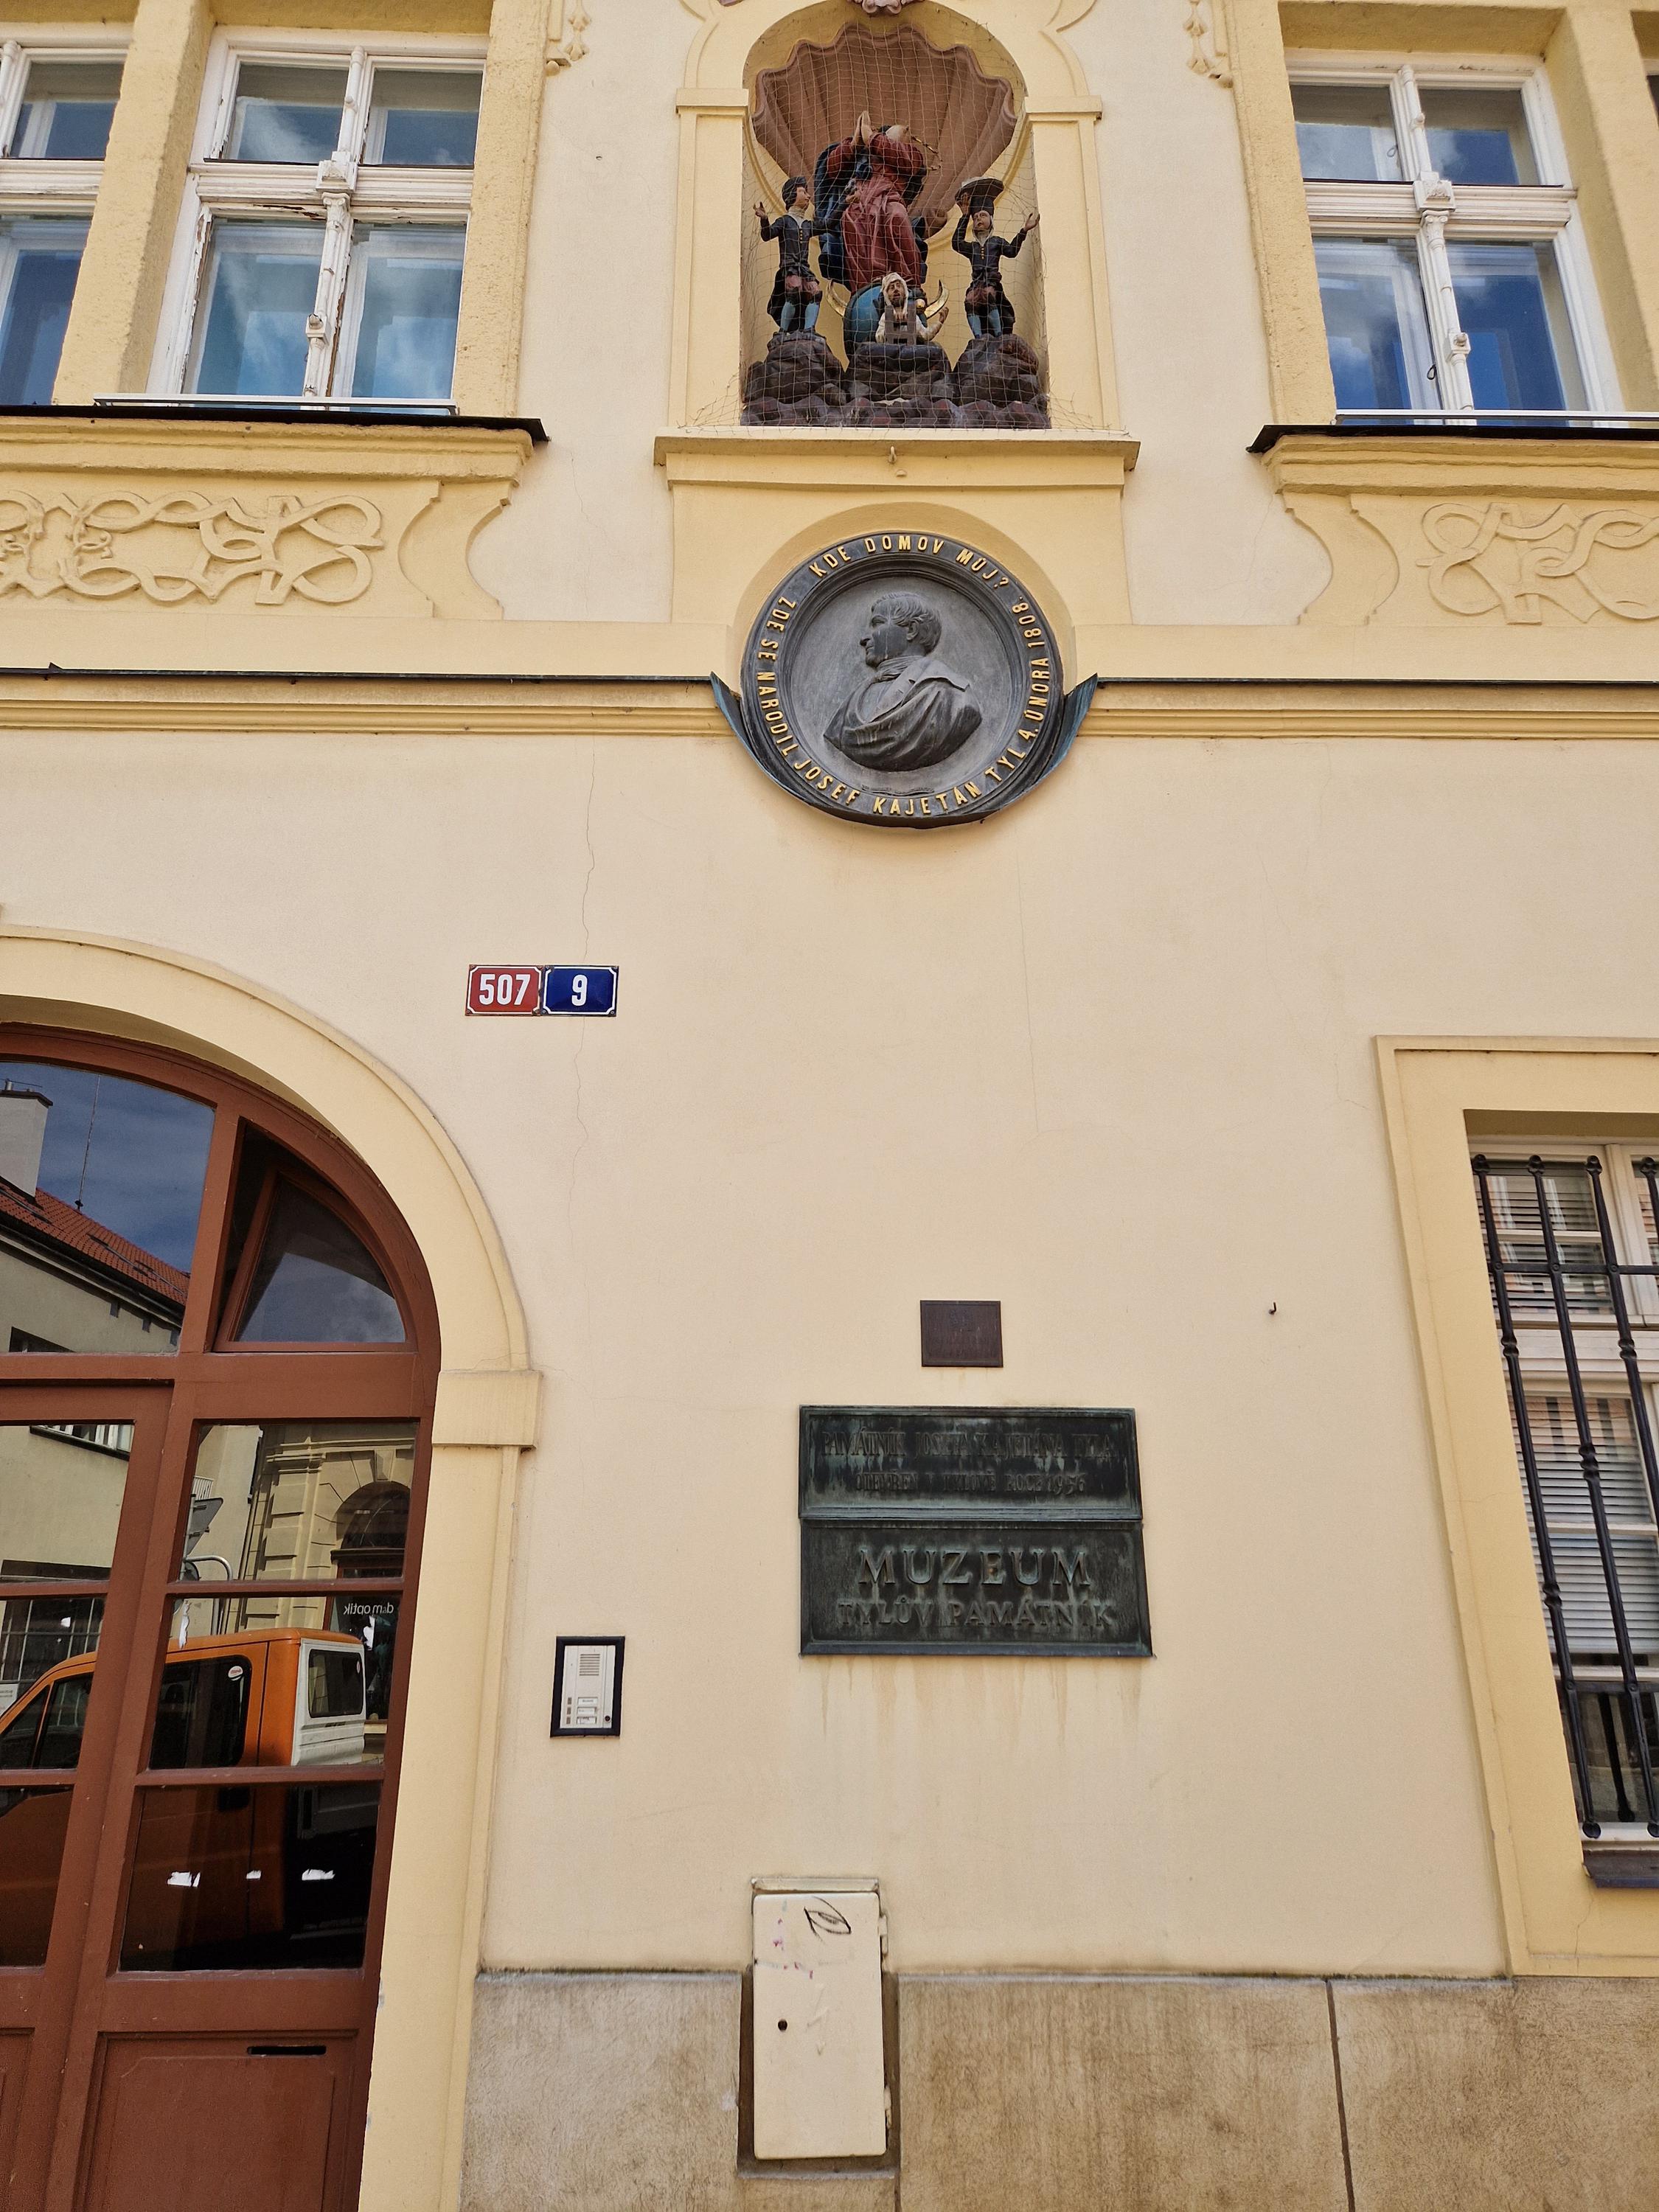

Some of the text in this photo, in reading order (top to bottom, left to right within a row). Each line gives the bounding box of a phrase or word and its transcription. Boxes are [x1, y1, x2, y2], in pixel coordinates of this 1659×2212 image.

[809, 535, 1009, 588] KDE DOMOV MŮJ?
[767, 597, 796, 631] ZDE
[1012, 595, 1046, 649] 1808.
[758, 639, 779, 660] SE
[1023, 658, 1050, 722] ÚNORA
[757, 672, 799, 757] NARODIL
[793, 759, 860, 805] JOSEF
[984, 747, 1026, 782] TYL
[479, 973, 531, 1006] 507
[571, 974, 588, 1006] 9
[822, 1426, 906, 1457] PAMÁTNÍK
[858, 1548, 1091, 1586] MUZEUM
[837, 1593, 1113, 1627] TYLŮV PAMÁTNÍK
